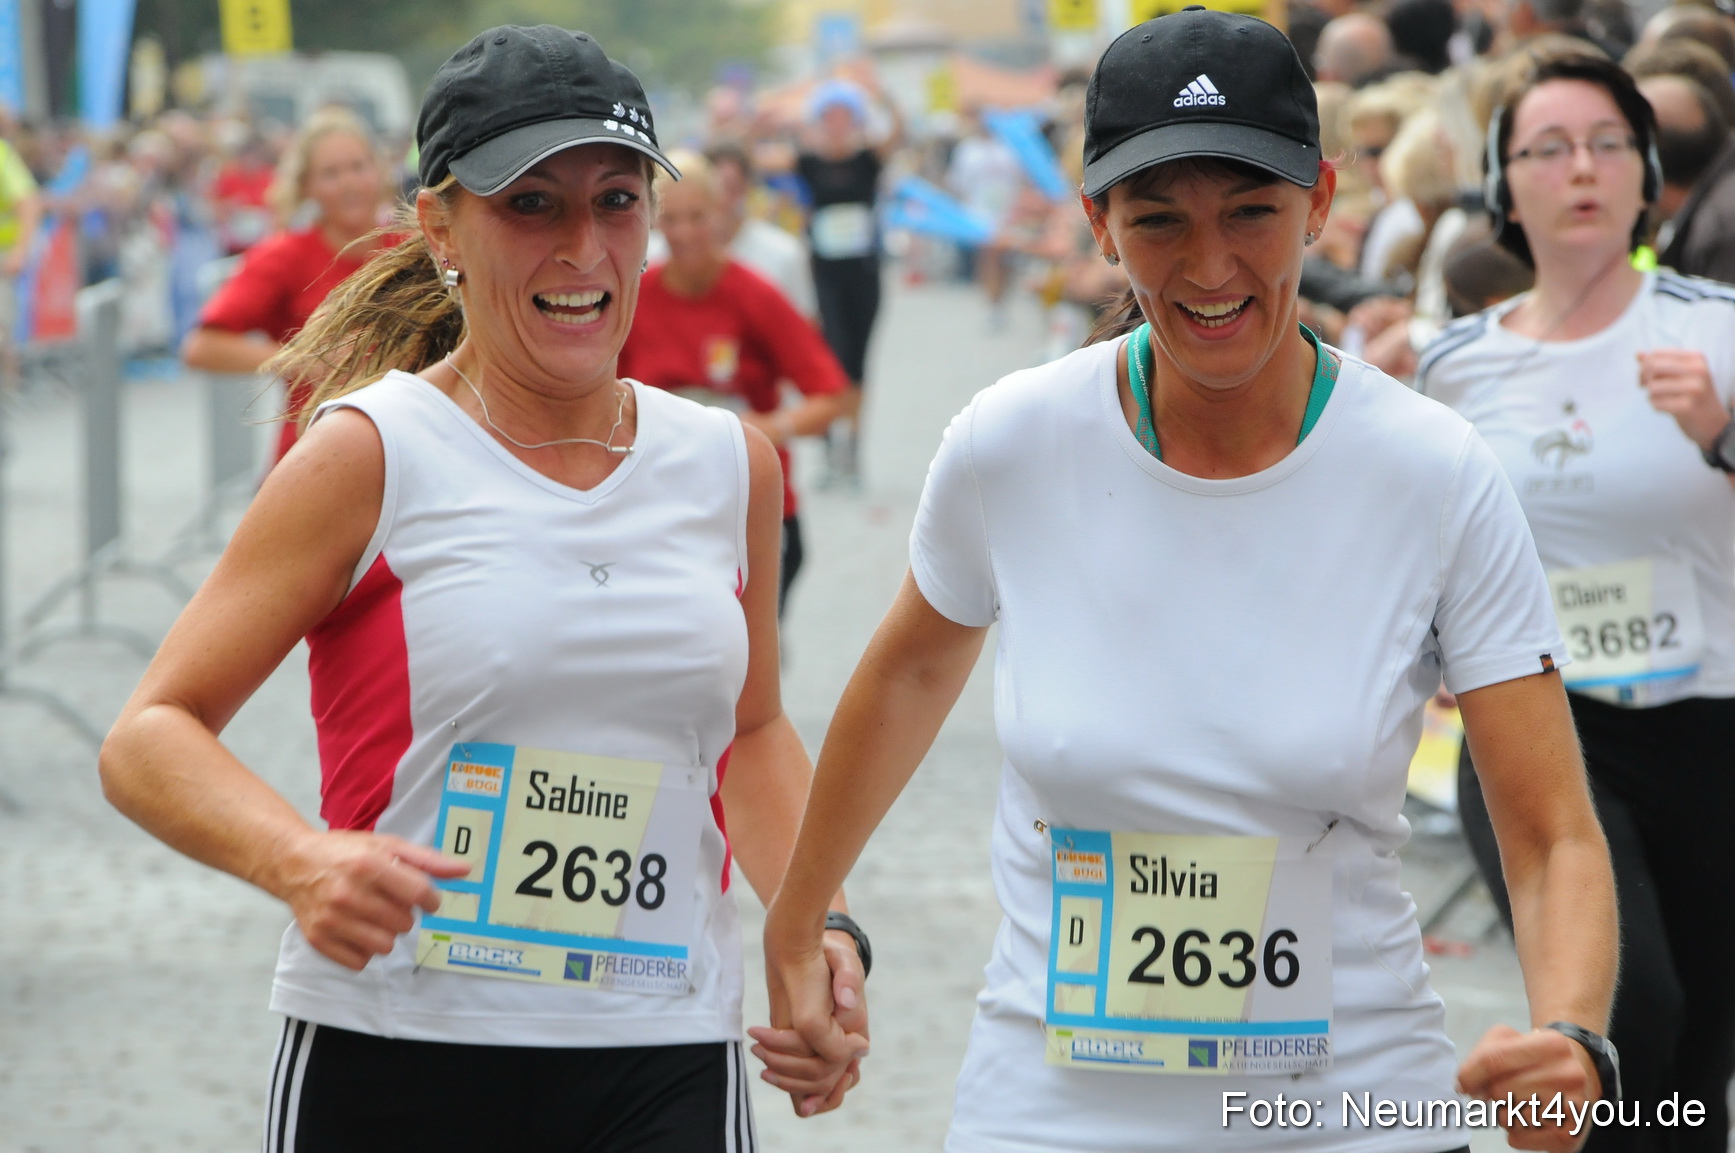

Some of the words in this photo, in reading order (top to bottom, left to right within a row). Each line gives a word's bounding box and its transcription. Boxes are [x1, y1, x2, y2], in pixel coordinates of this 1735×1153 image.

[1173, 93, 1227, 108] adidas
[1558, 583, 1626, 610] Claire
[1569, 613, 1679, 660] 3682
[526, 770, 628, 819] Sabine
[454, 827, 472, 855] D
[515, 840, 667, 910] 2638
[1130, 854, 1218, 899] Silvia
[1069, 917, 1084, 946] D
[448, 943, 524, 966] BOCK
[595, 955, 688, 979] PFLEIDERER
[1127, 926, 1300, 988] 2636
[1072, 1040, 1144, 1059] BOCK
[1222, 1038, 1328, 1058] PFLEIDERER
